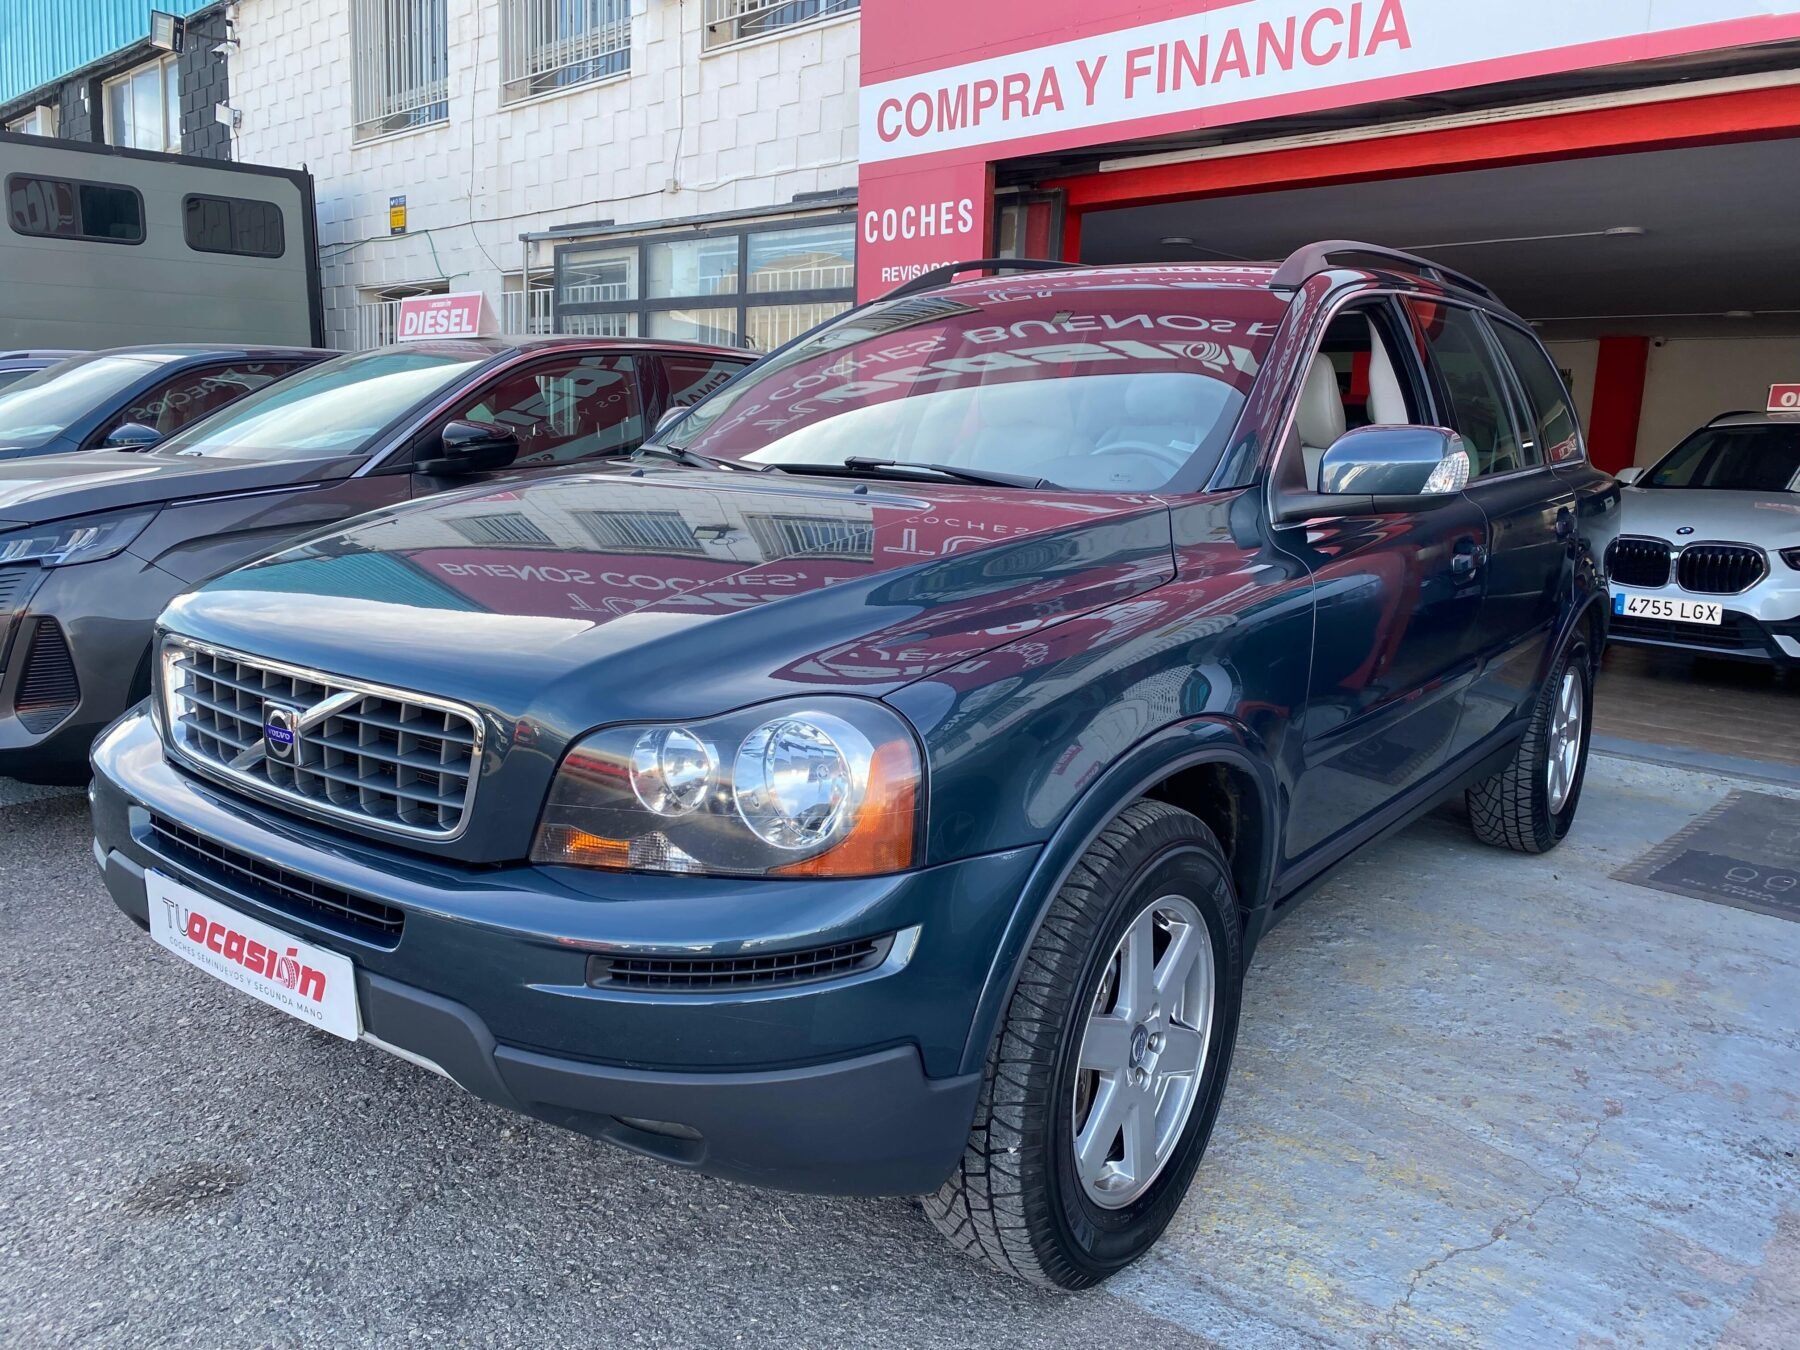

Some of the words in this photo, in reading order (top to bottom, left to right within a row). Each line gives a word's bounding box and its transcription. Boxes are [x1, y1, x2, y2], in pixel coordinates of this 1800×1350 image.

[877, 66, 1065, 143] COMPRA
[1076, 55, 1108, 106] Y
[1124, 0, 1412, 99] FINANCIA
[864, 198, 973, 244] COCHES
[403, 308, 473, 335] DIESEL
[1628, 598, 1673, 616] 4755
[1680, 603, 1717, 621] LGX
[268, 728, 290, 740] VOLVO
[169, 936, 195, 958] COCHES
[197, 952, 244, 982] SEMINUEVOS
[254, 981, 293, 1008] SEGUNDA
[296, 1001, 324, 1021] MANO
